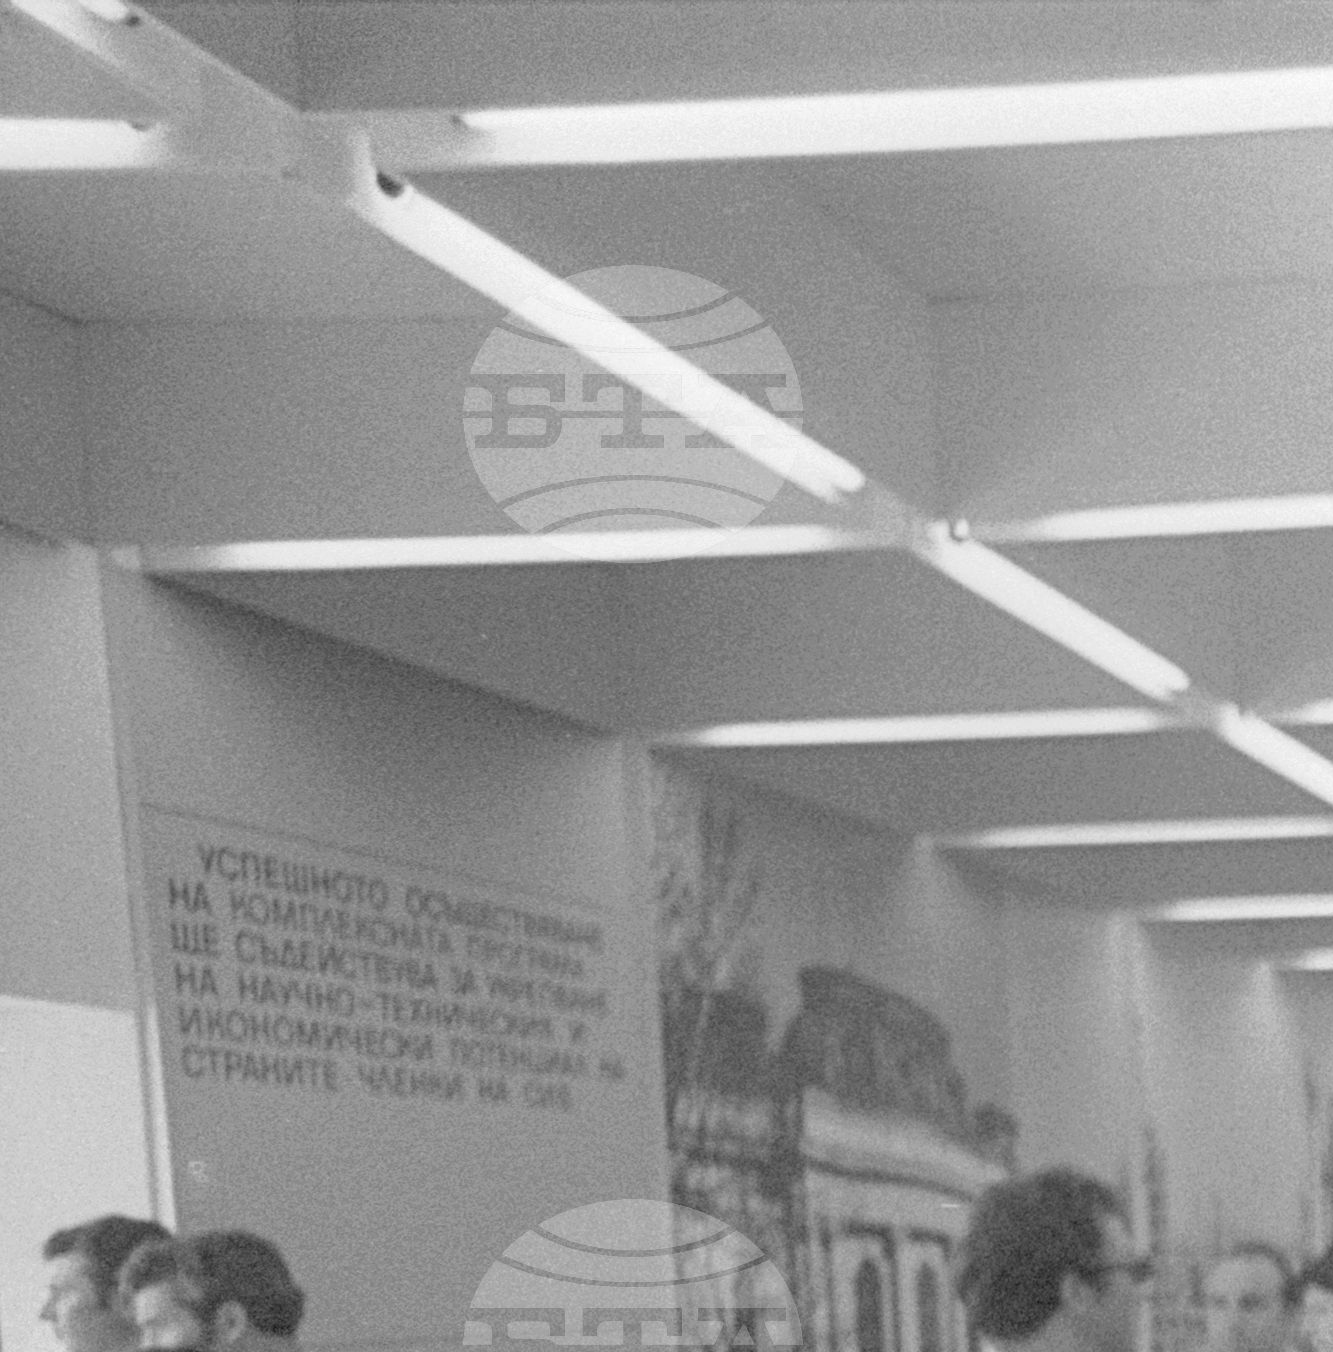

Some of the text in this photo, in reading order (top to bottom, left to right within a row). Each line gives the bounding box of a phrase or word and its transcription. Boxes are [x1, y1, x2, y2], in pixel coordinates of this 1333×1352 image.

[167, 877, 212, 916] НА
[197, 843, 389, 910] УСПЕШНОТО
[173, 962, 219, 998] НА
[182, 1044, 339, 1092] СТРАНИТЕ
